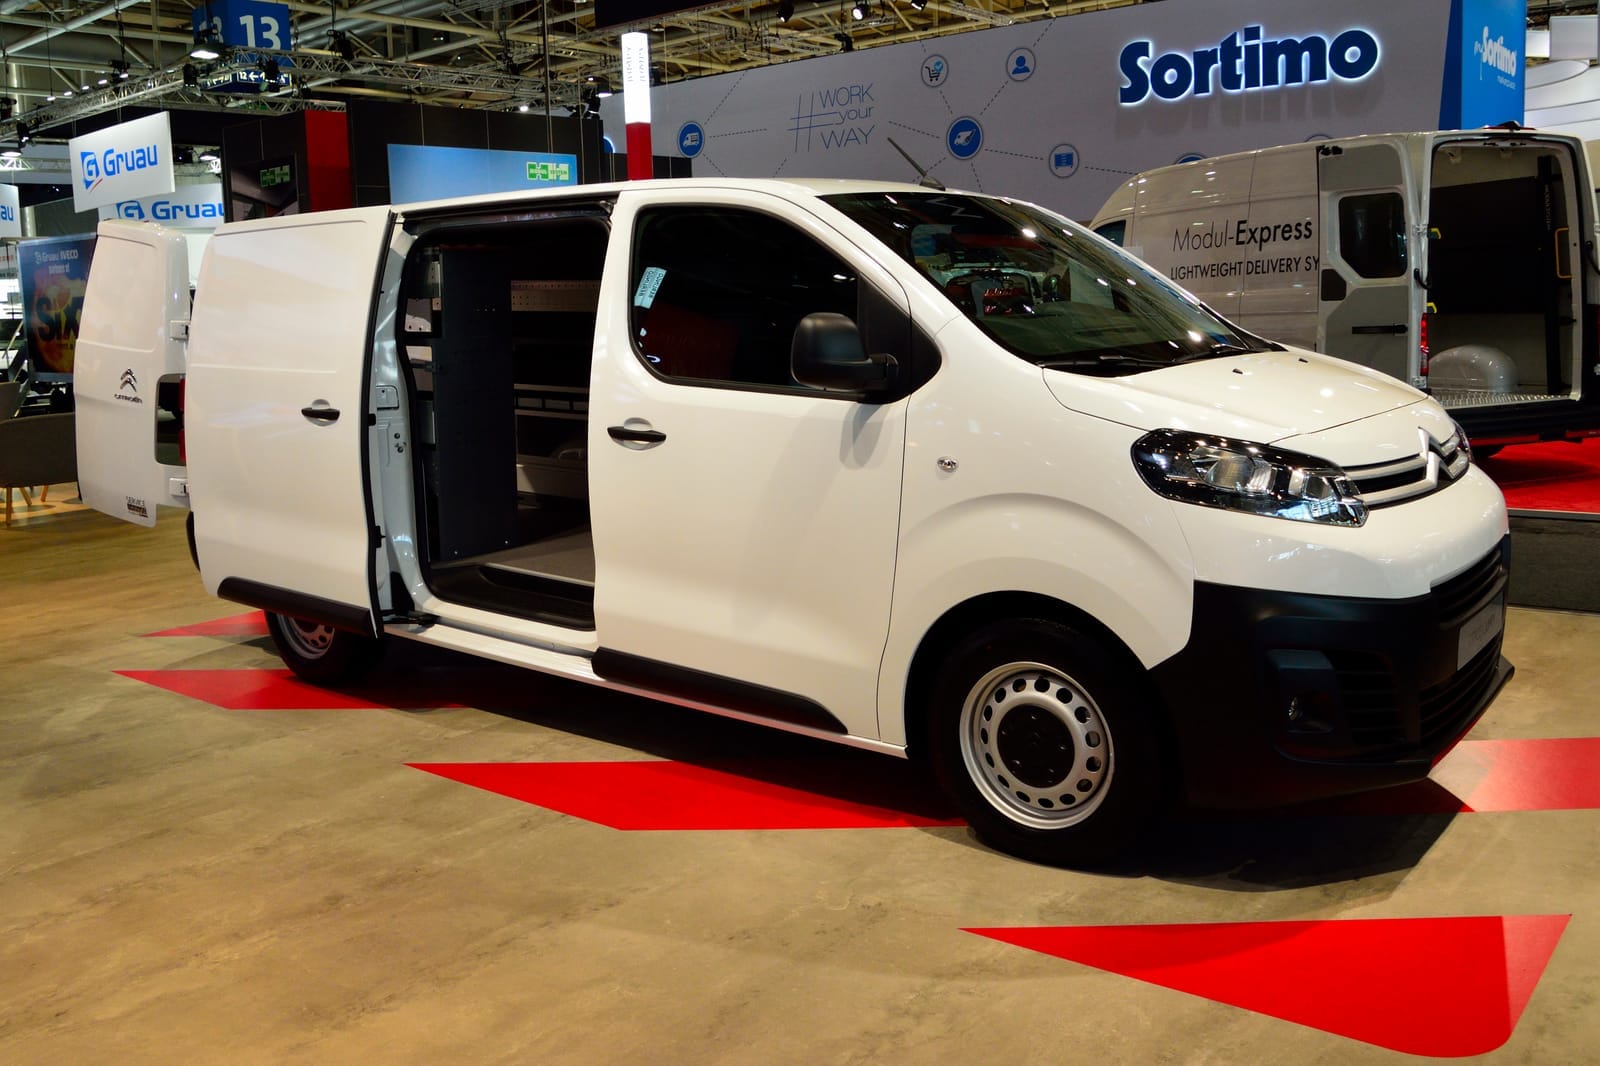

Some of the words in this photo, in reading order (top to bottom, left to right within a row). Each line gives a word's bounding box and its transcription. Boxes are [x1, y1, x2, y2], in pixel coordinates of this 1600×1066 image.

[239, 15, 281, 50] 13
[1119, 25, 1378, 104] Sortimo
[838, 106, 874, 125] your
[821, 125, 875, 149] WAY
[103, 145, 158, 176] Gruau
[1172, 219, 1313, 252] Modul-Express
[1170, 261, 1243, 280] LIGHTWEIGHT
[1246, 257, 1301, 276] DELIVERY
